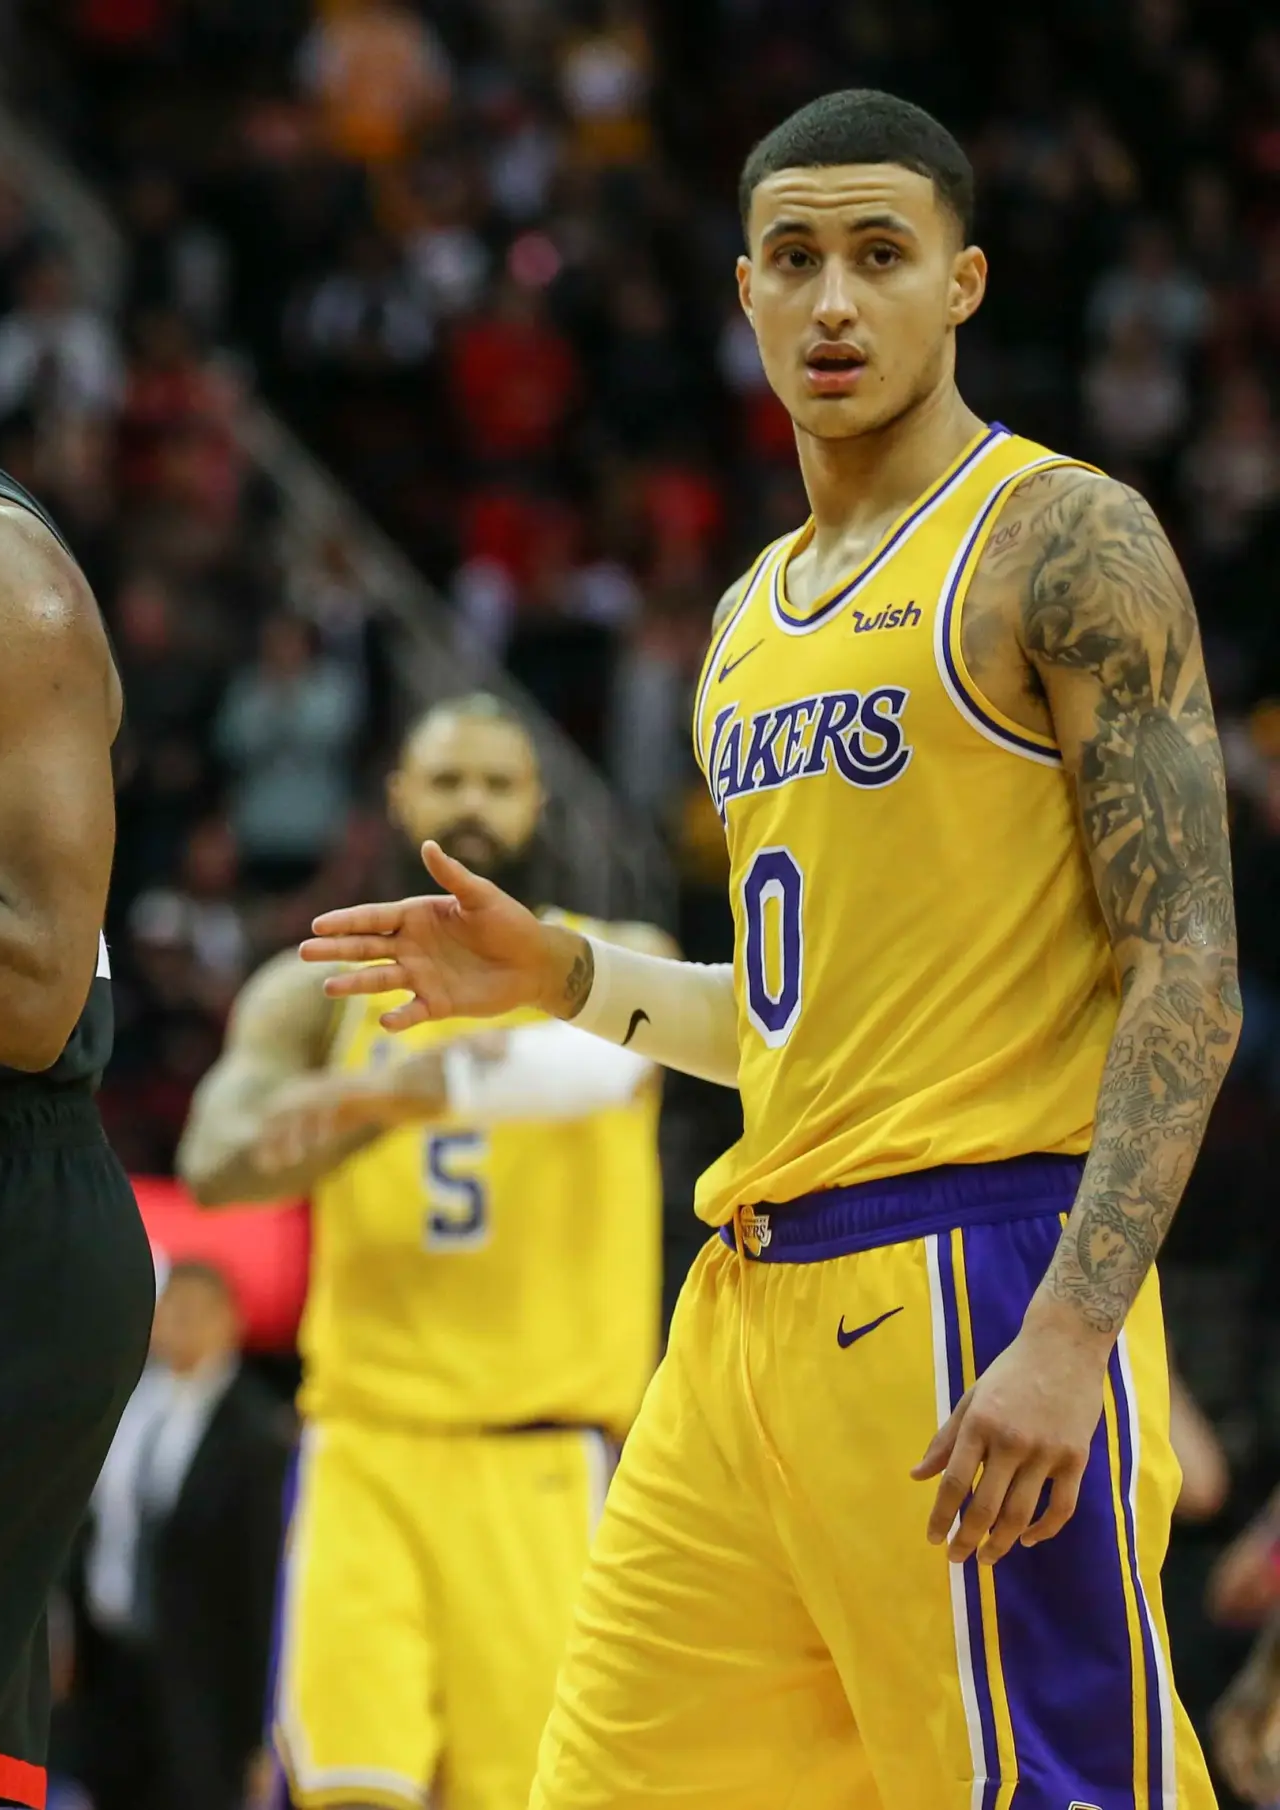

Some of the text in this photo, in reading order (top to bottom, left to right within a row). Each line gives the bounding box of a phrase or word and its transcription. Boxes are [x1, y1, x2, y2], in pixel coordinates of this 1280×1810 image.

[852, 600, 922, 634] wish
[741, 845, 803, 1049] 0
[424, 1128, 488, 1250] 5
